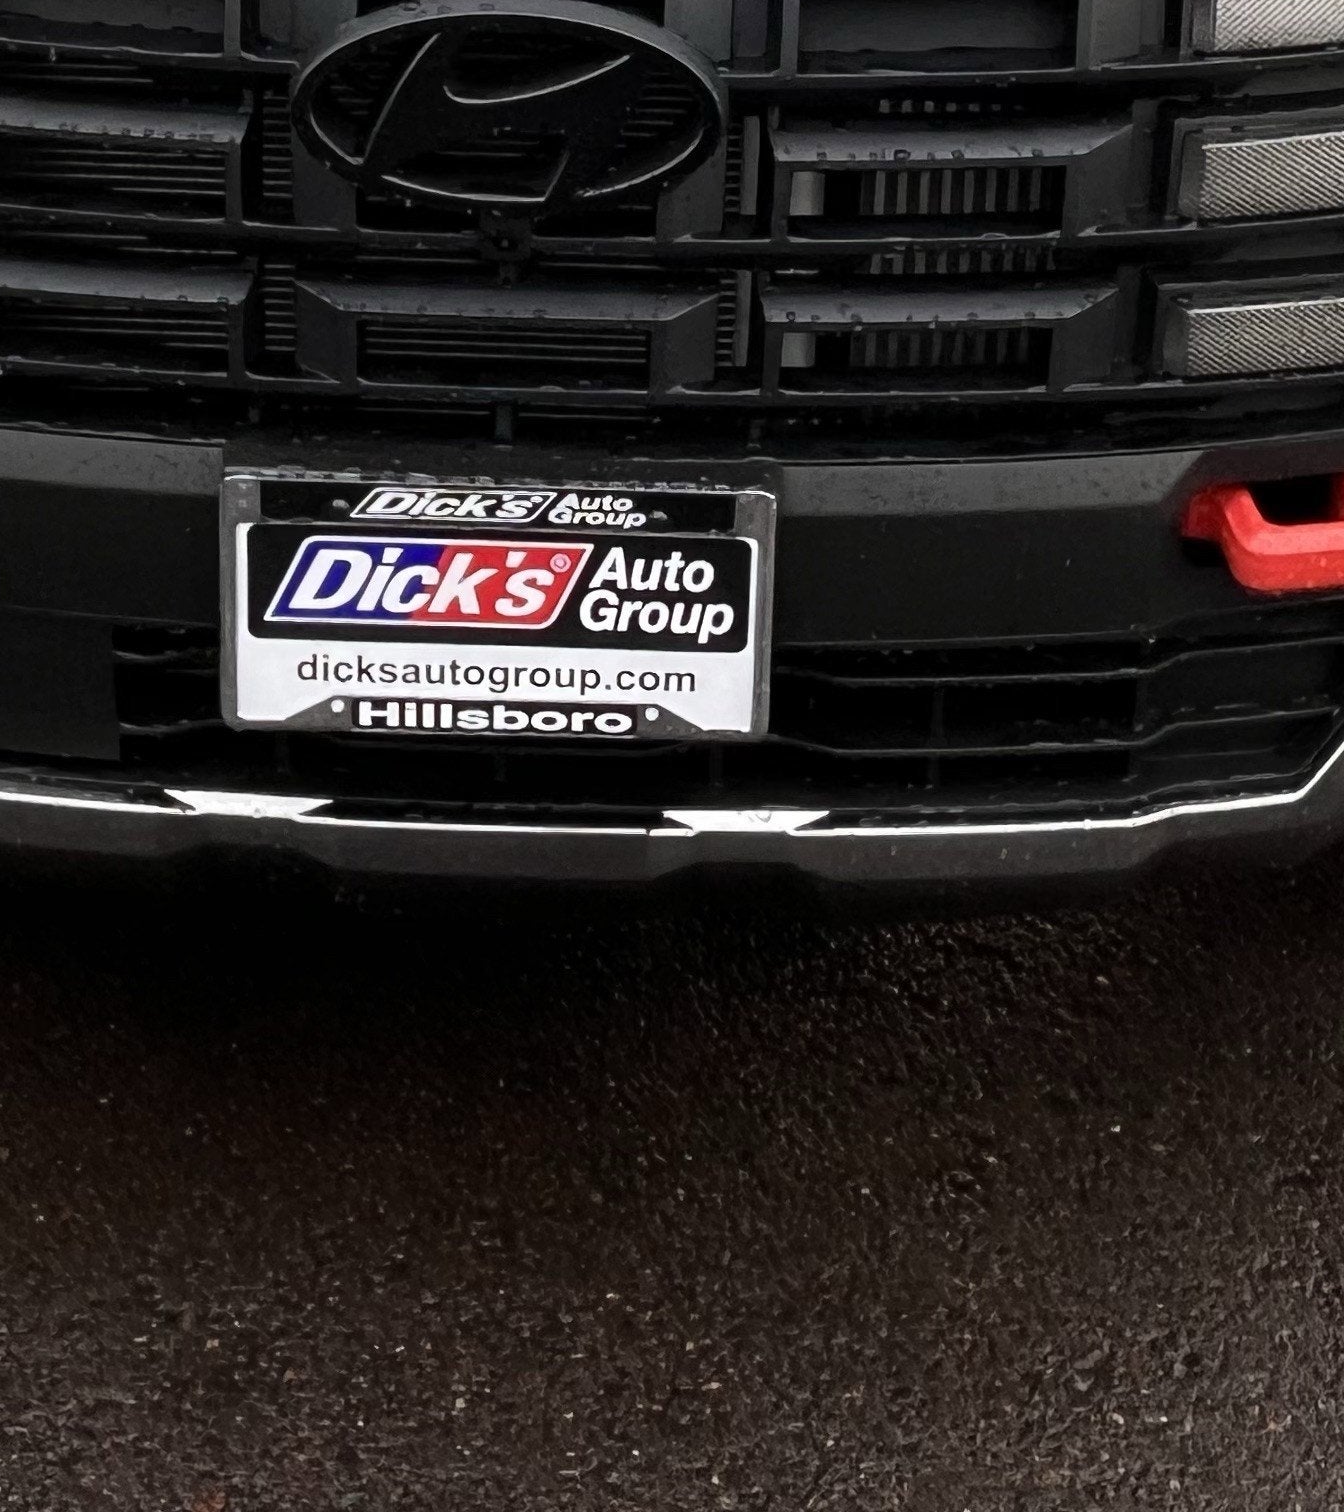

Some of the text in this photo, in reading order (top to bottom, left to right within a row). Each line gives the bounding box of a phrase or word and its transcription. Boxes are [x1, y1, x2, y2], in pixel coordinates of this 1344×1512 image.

[366, 491, 535, 518] Dick's
[548, 506, 647, 529] Group
[559, 492, 633, 512] Auto
[288, 546, 554, 616] Dick's
[589, 546, 715, 593] Auto
[579, 590, 735, 643] Group
[297, 654, 696, 695] dicksautogroup.com
[358, 700, 633, 735] Hillsboro
